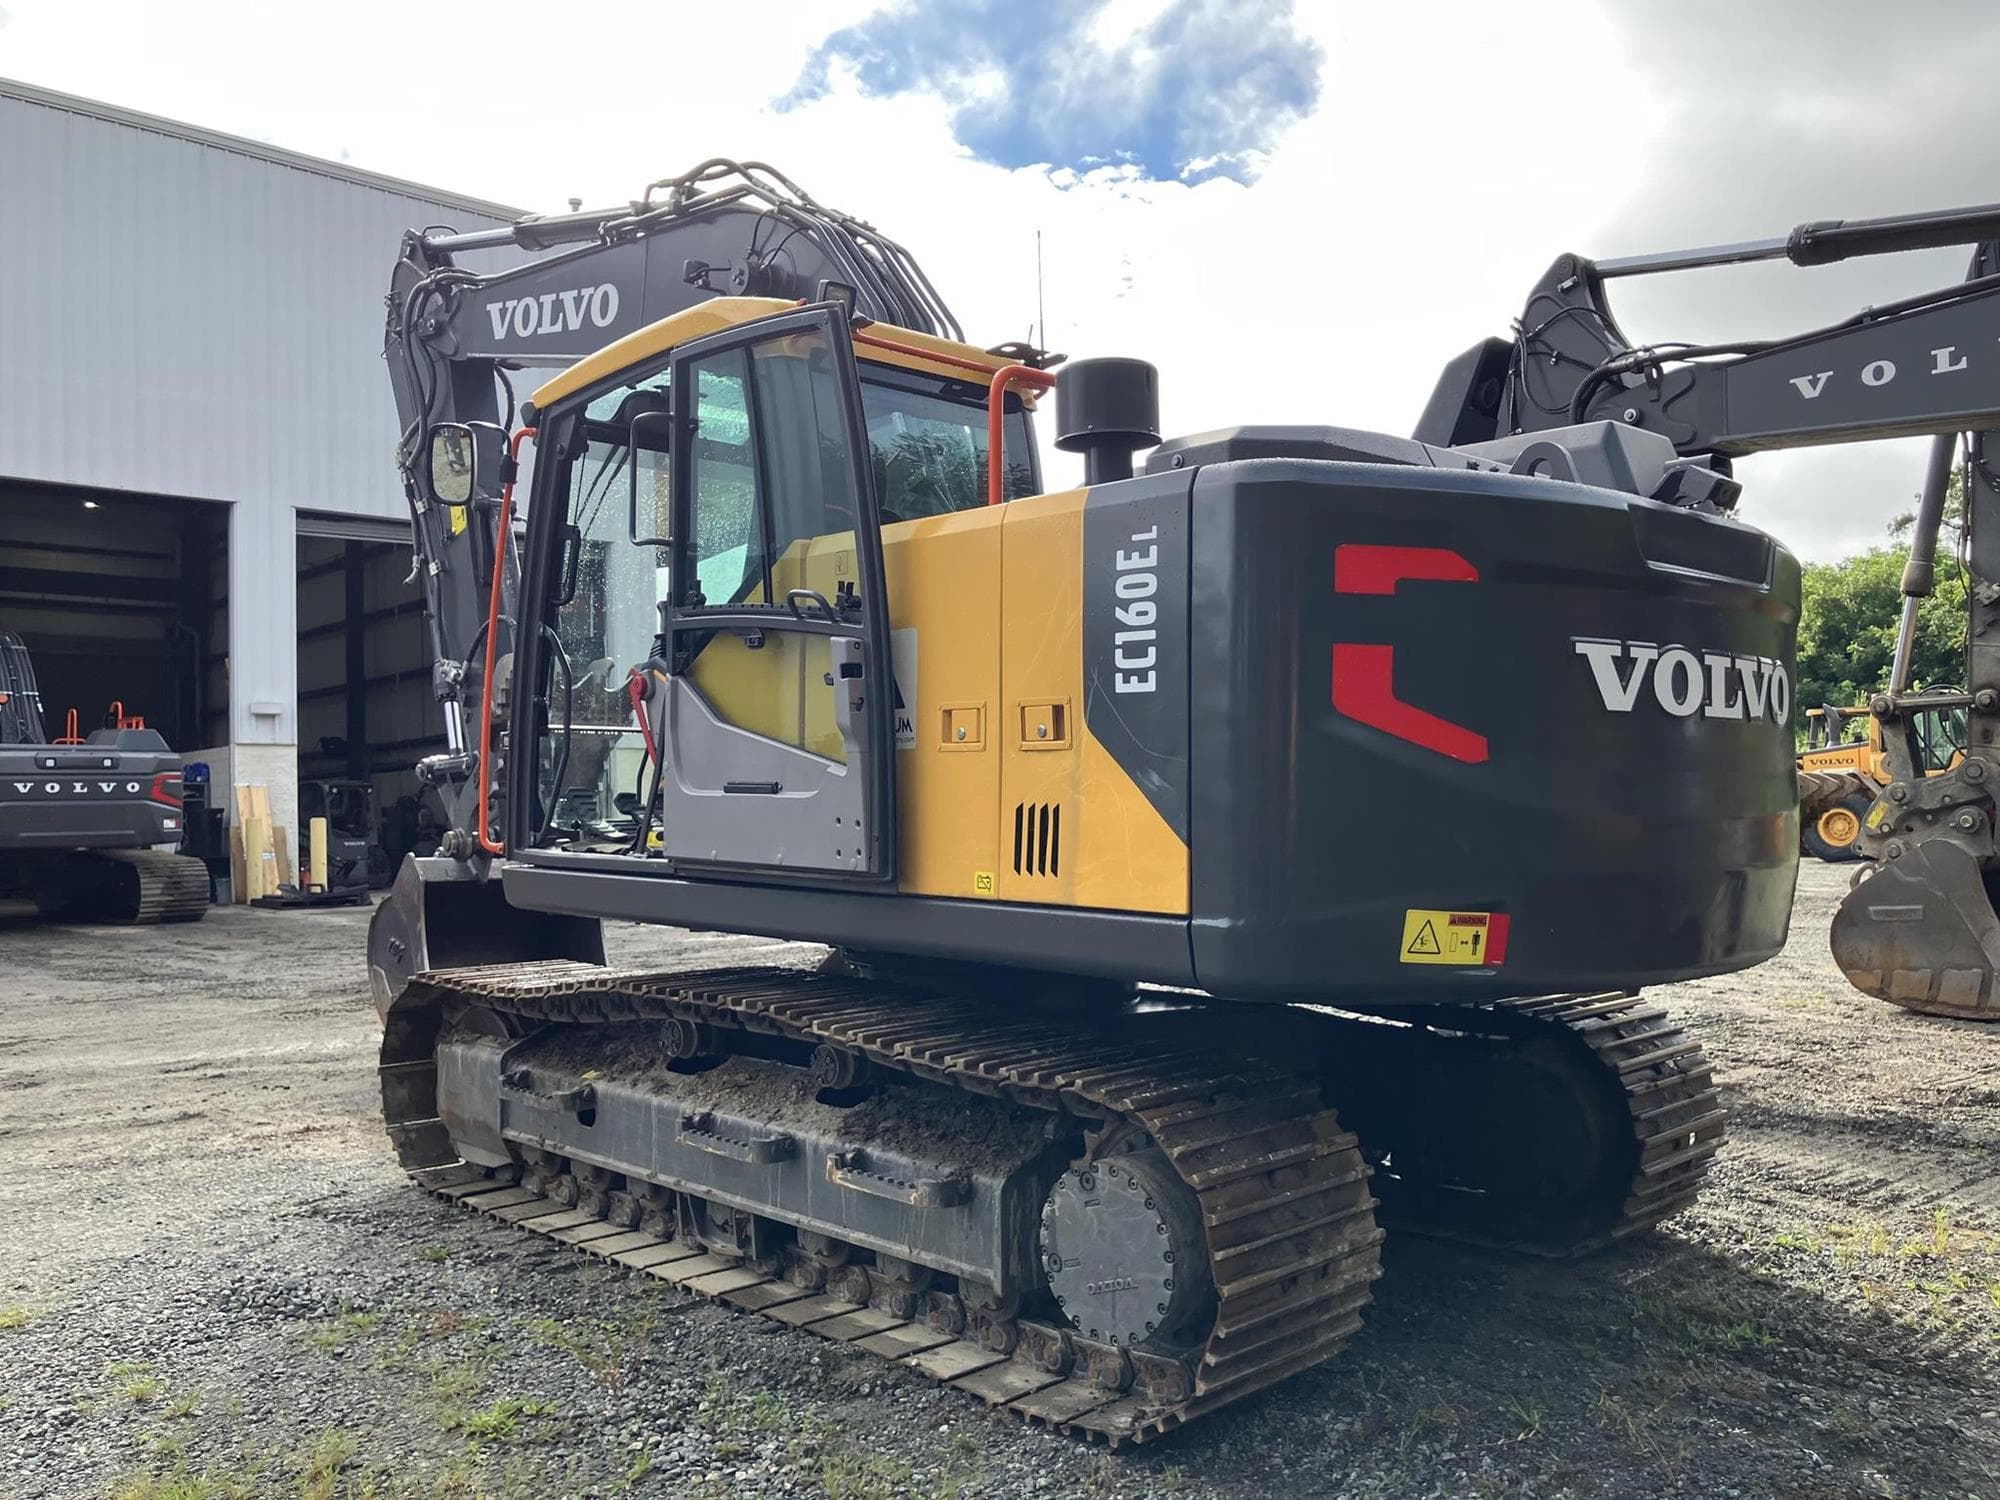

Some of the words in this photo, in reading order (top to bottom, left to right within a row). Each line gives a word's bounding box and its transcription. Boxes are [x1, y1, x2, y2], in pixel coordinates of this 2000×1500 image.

[486, 283, 619, 340] VOLVO
[1789, 338, 2000, 399] VOL
[1574, 639, 1790, 729] VOLVO
[13, 782, 140, 794] VOLVO
[1809, 758, 1855, 766] VOLVO
